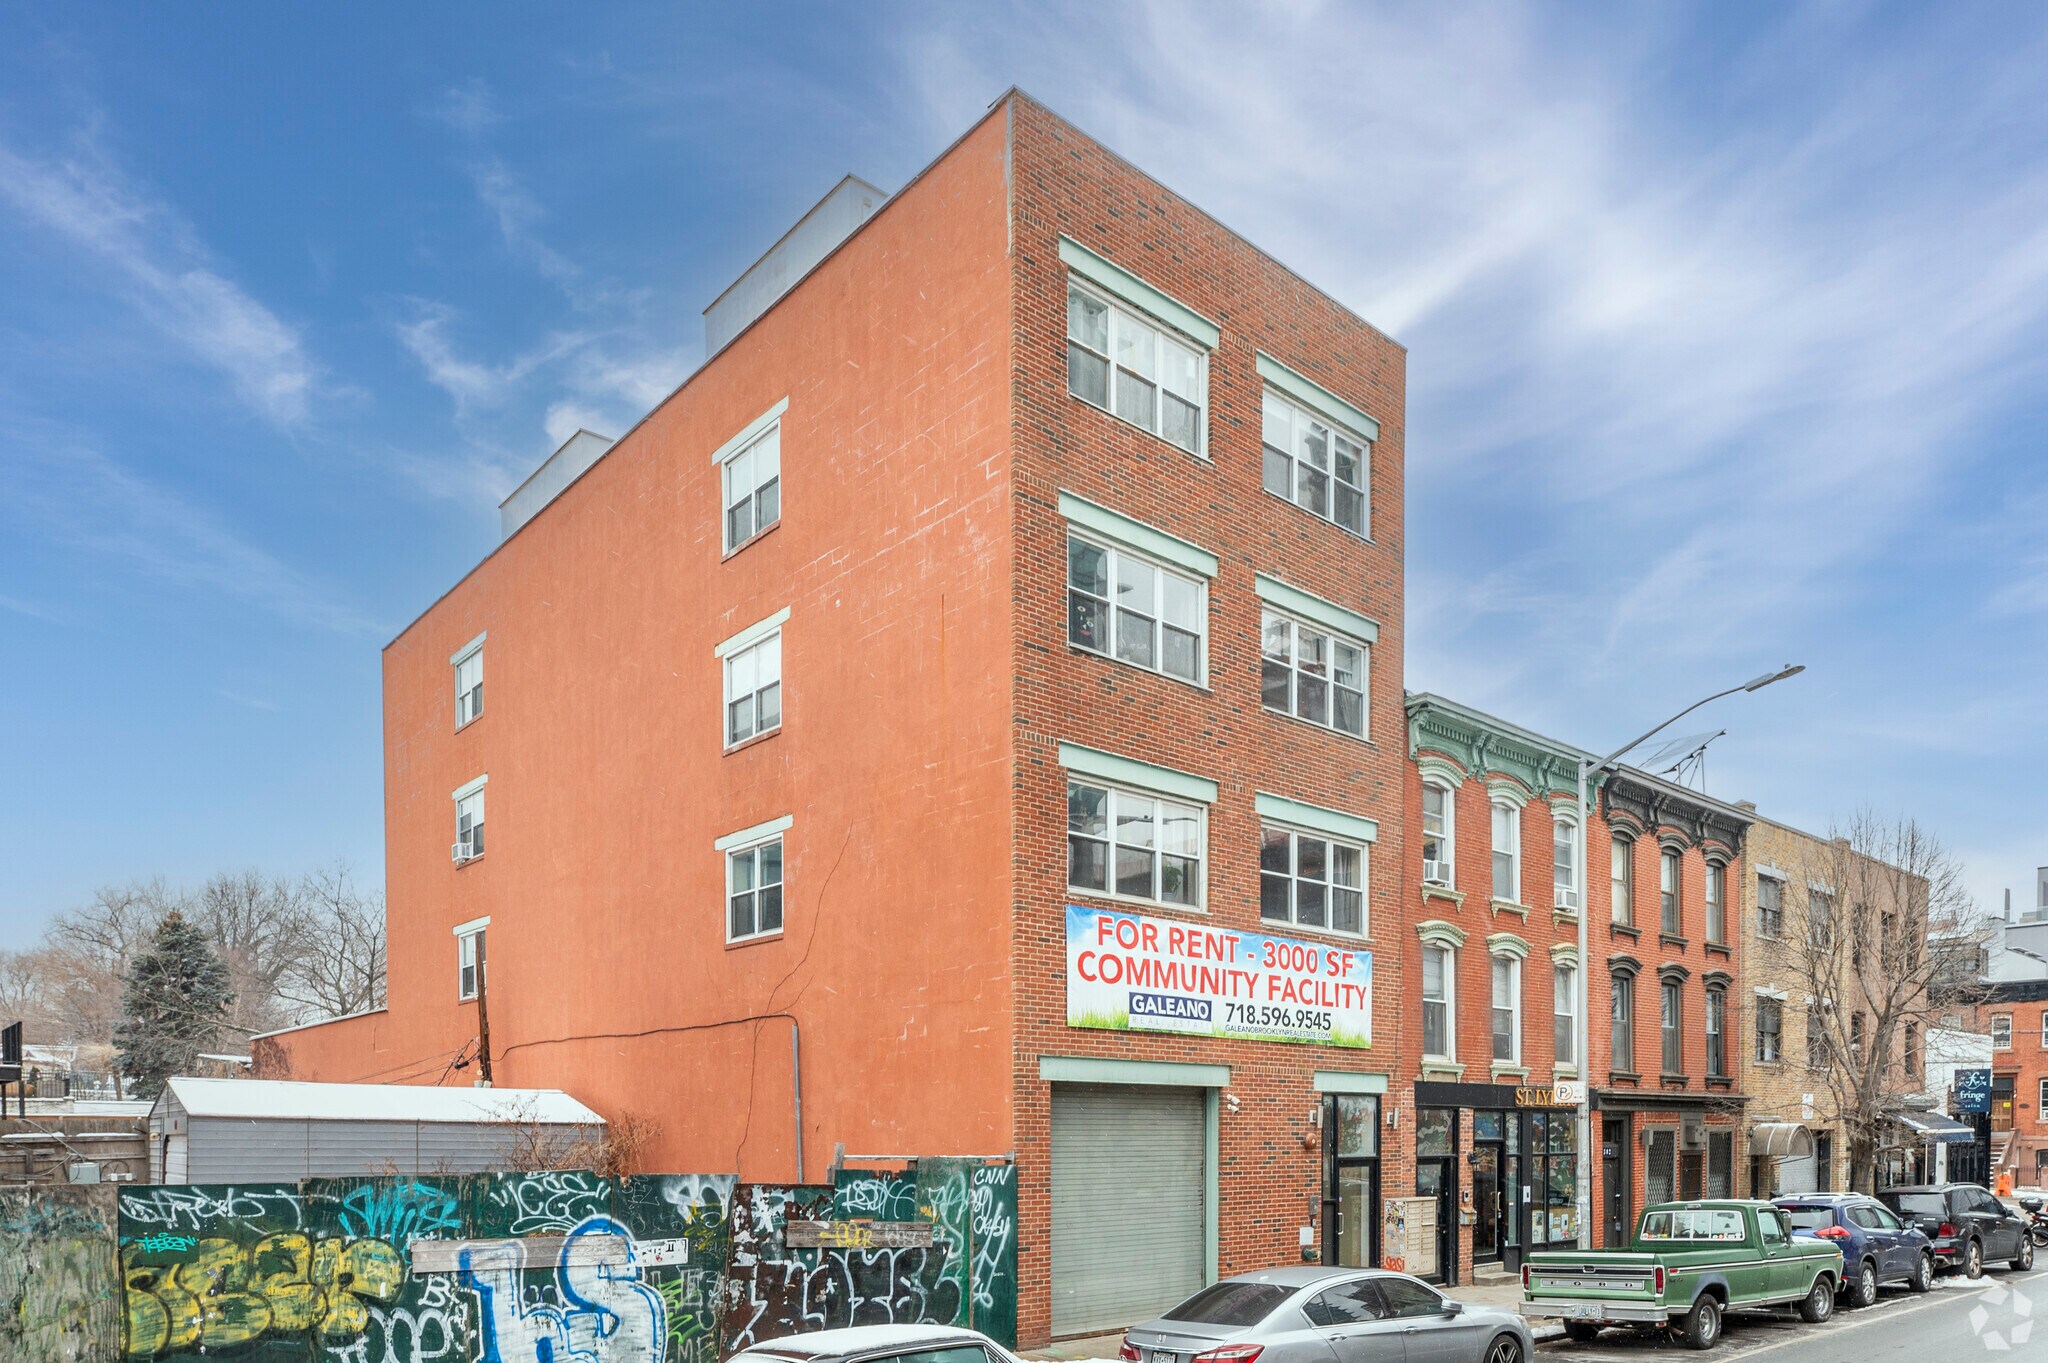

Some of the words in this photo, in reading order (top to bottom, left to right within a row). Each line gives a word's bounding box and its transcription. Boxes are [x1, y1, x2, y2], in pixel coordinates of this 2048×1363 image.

[1097, 916, 1159, 953] FOR
[1169, 926, 1239, 963] RENT
[1262, 941, 1318, 974] 3000
[1326, 950, 1354, 977] SF
[1077, 950, 1259, 999] COMMUNITY
[1268, 974, 1367, 1010] FACILITY
[1131, 994, 1210, 1020] GALEANO
[1225, 1002, 1332, 1031] 718.596.9545
[1132, 1015, 1160, 1026] REAL
[1173, 1018, 1211, 1031] ESTAT
[1516, 1088, 1533, 1106] ST.
[1960, 1090, 1985, 1102] fringe
